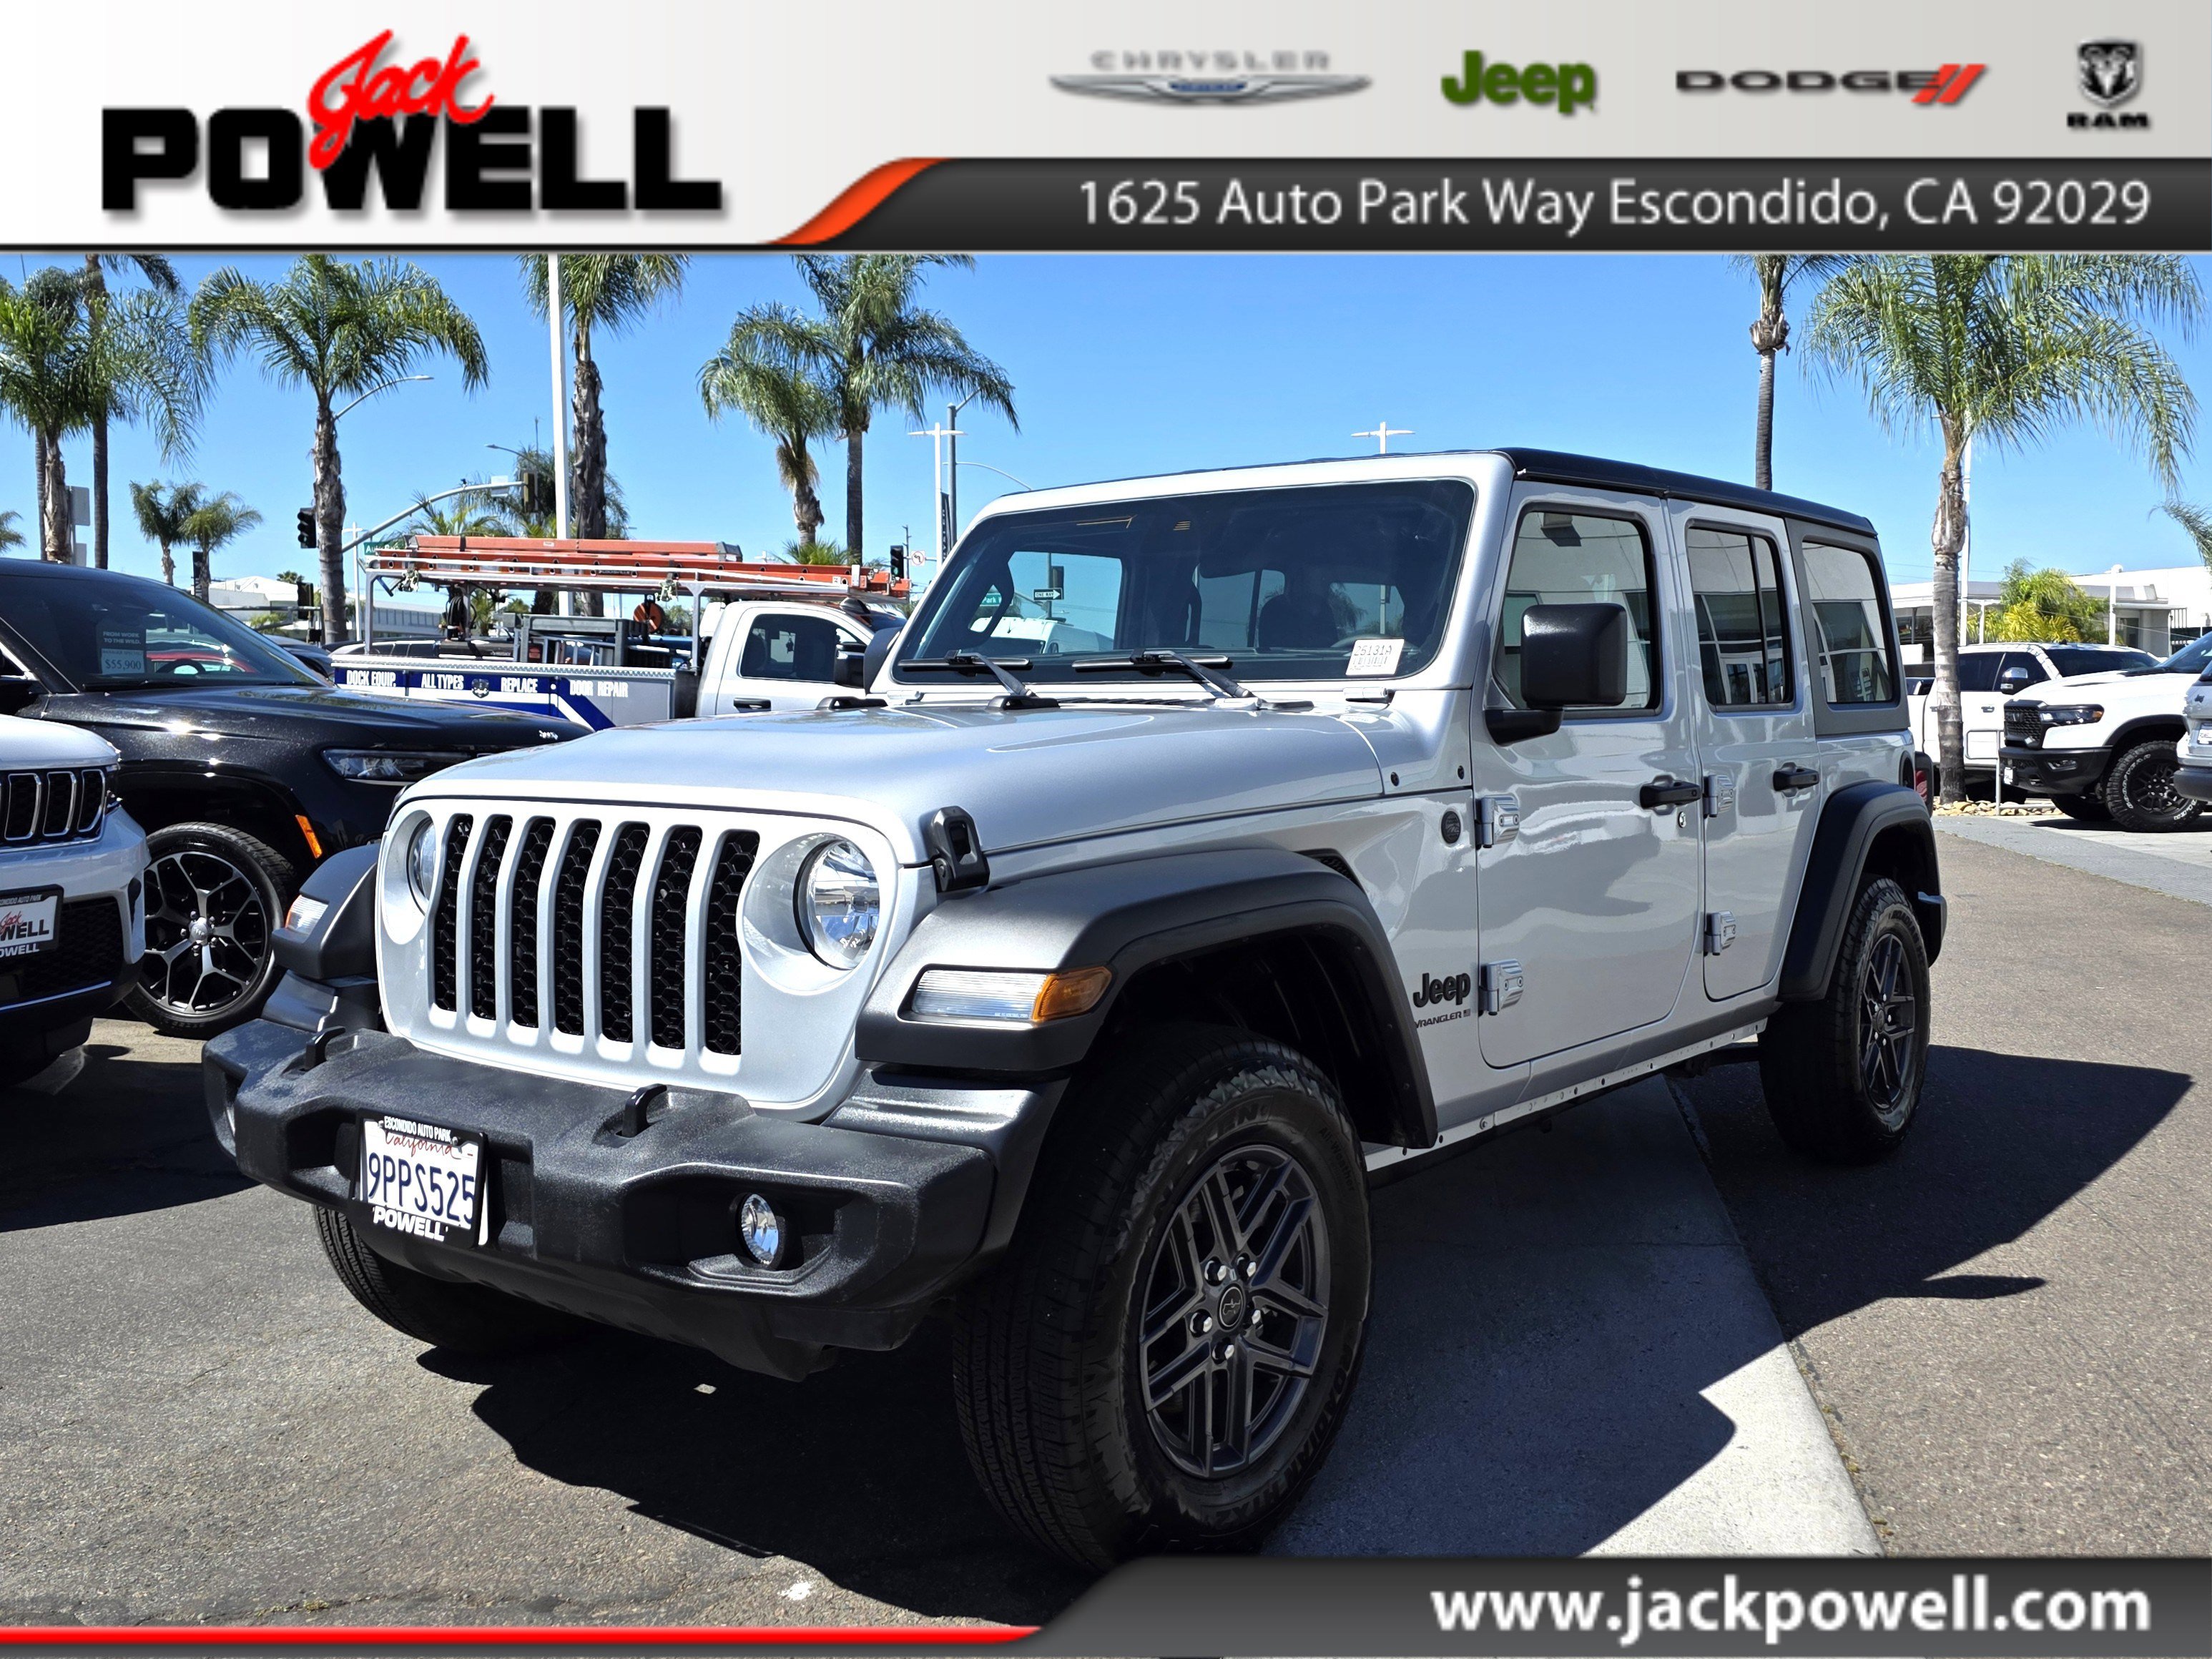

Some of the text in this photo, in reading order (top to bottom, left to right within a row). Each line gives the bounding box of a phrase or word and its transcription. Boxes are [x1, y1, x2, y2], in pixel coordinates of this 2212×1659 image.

[1354, 644, 1392, 656] 25131A
[104, 659, 142, 671] $55,900
[347, 670, 396, 687] DOCK EQUIP.
[421, 674, 464, 690] ALL TYPES
[501, 677, 538, 693] REPLACE
[569, 680, 629, 697] DOOR REPAIR
[1412, 973, 1471, 1008] Jeep
[384, 1116, 452, 1142] ESCONDIDO AUTO PARK
[385, 1131, 461, 1160] California
[368, 1152, 475, 1224] 9PPS525
[373, 1206, 444, 1242] POWELL
